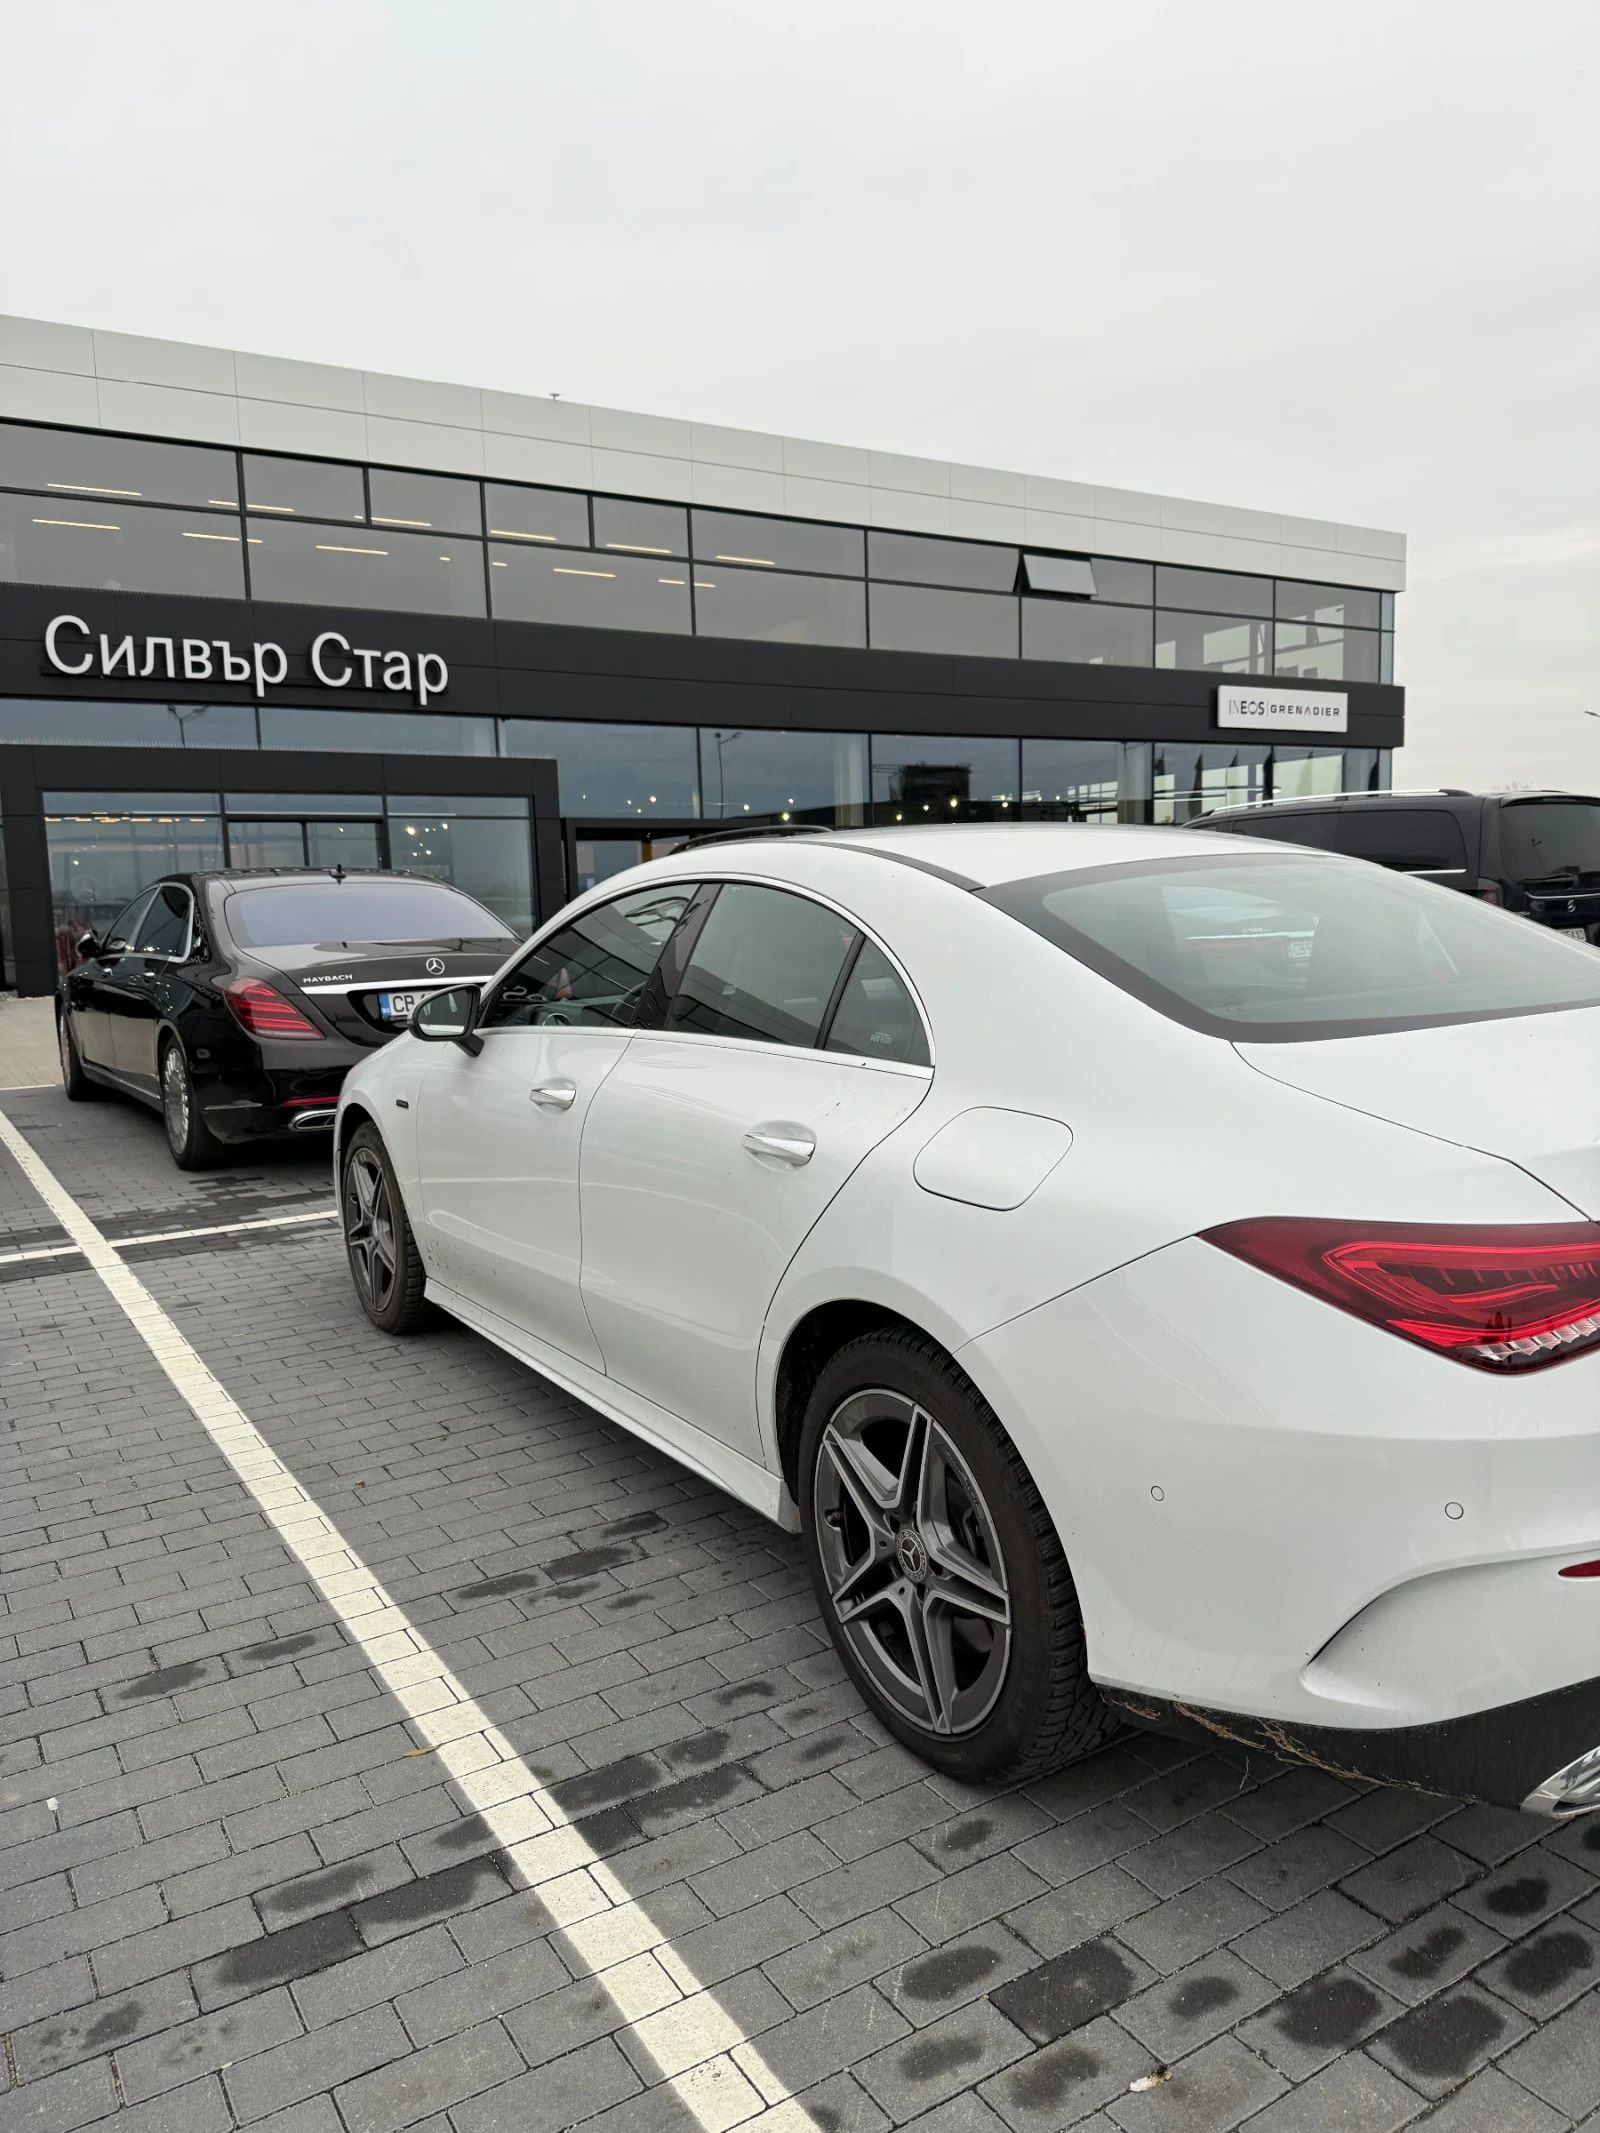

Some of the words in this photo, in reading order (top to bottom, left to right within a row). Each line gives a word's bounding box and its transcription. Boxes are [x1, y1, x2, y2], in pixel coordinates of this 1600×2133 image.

[44, 614, 288, 697] Силвър
[311, 631, 449, 706] Стар
[1228, 699, 1265, 716] INEOS
[1270, 704, 1340, 717] GRENADIER
[302, 974, 353, 983] MAYBACH
